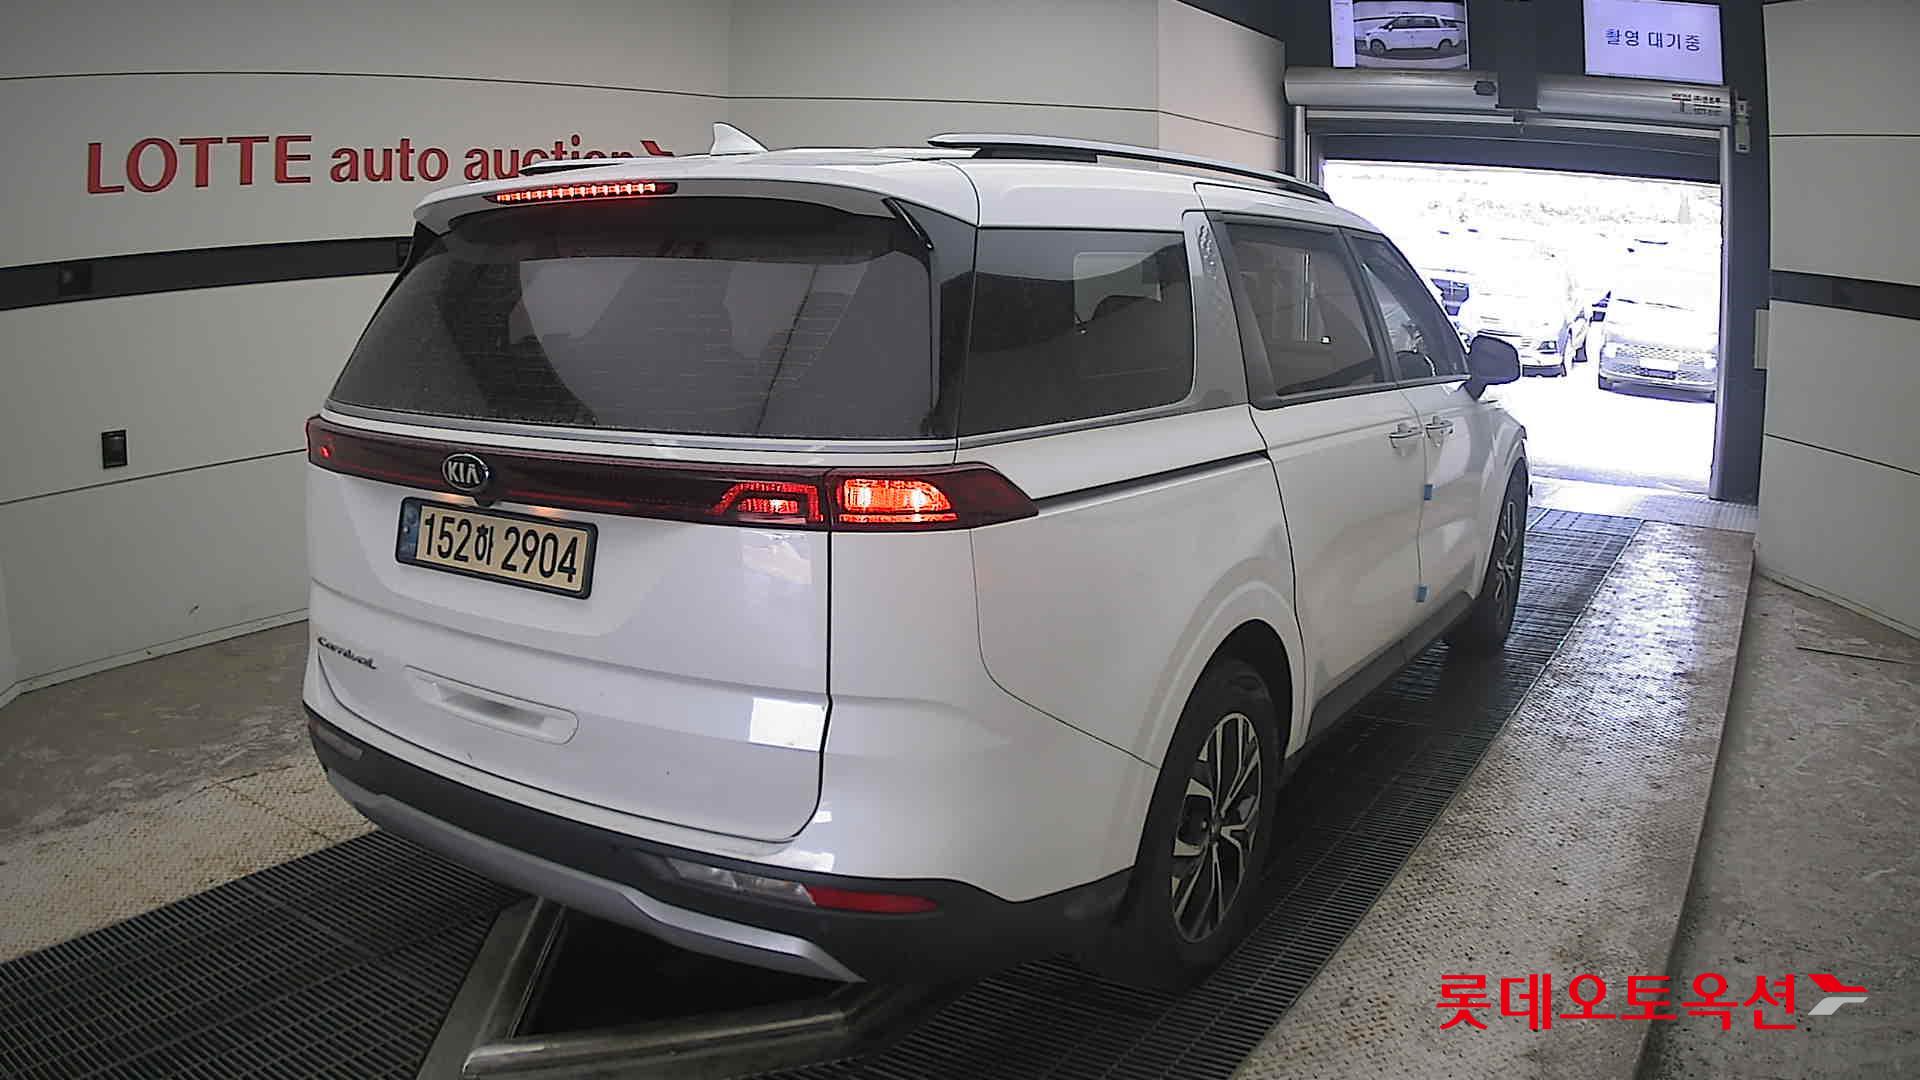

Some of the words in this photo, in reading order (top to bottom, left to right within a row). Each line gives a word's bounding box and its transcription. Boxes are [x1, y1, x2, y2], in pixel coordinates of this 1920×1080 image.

[1648, 31, 1701, 51] 대기중
[87, 135, 312, 194] LOTTE
[330, 138, 449, 182] auto
[464, 135, 633, 181] aucti
[448, 461, 480, 484] KIA
[424, 514, 495, 565] 152하
[501, 525, 579, 583] 2904
